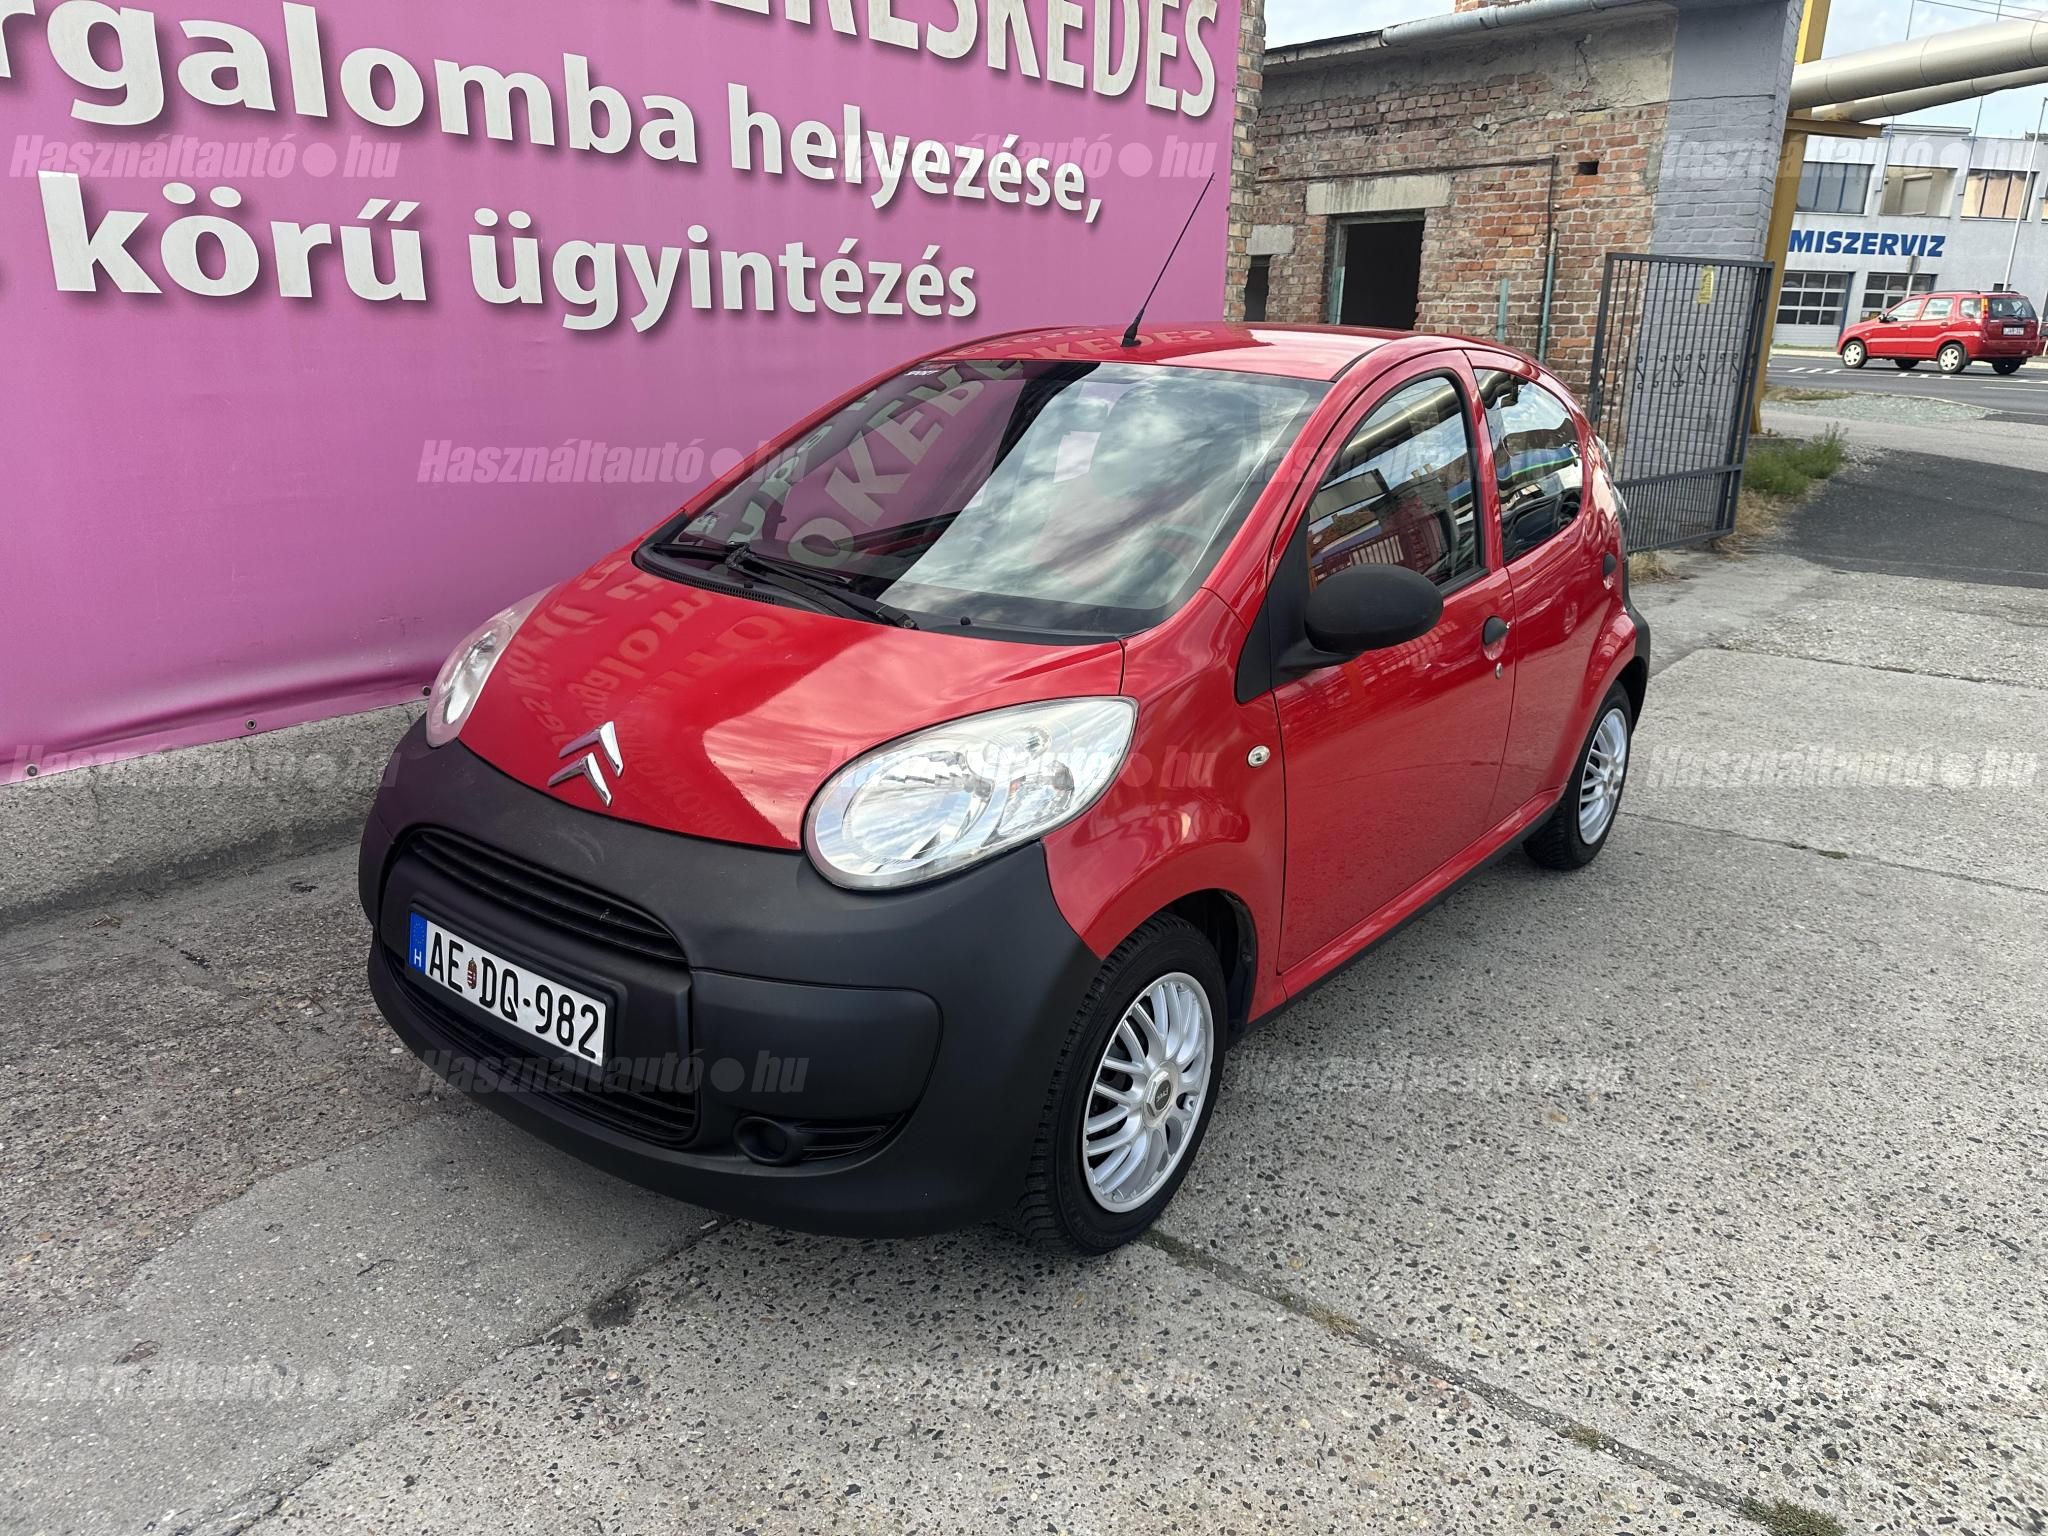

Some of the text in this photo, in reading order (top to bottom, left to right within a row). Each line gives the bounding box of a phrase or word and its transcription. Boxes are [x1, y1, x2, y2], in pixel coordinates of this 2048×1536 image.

[728, 82, 1101, 223] helyezése,
[38, 170, 976, 332] körű ügyintézés
[1788, 230, 1946, 257] MISZERVIZ
[429, 931, 599, 1059] AE DQ-982
